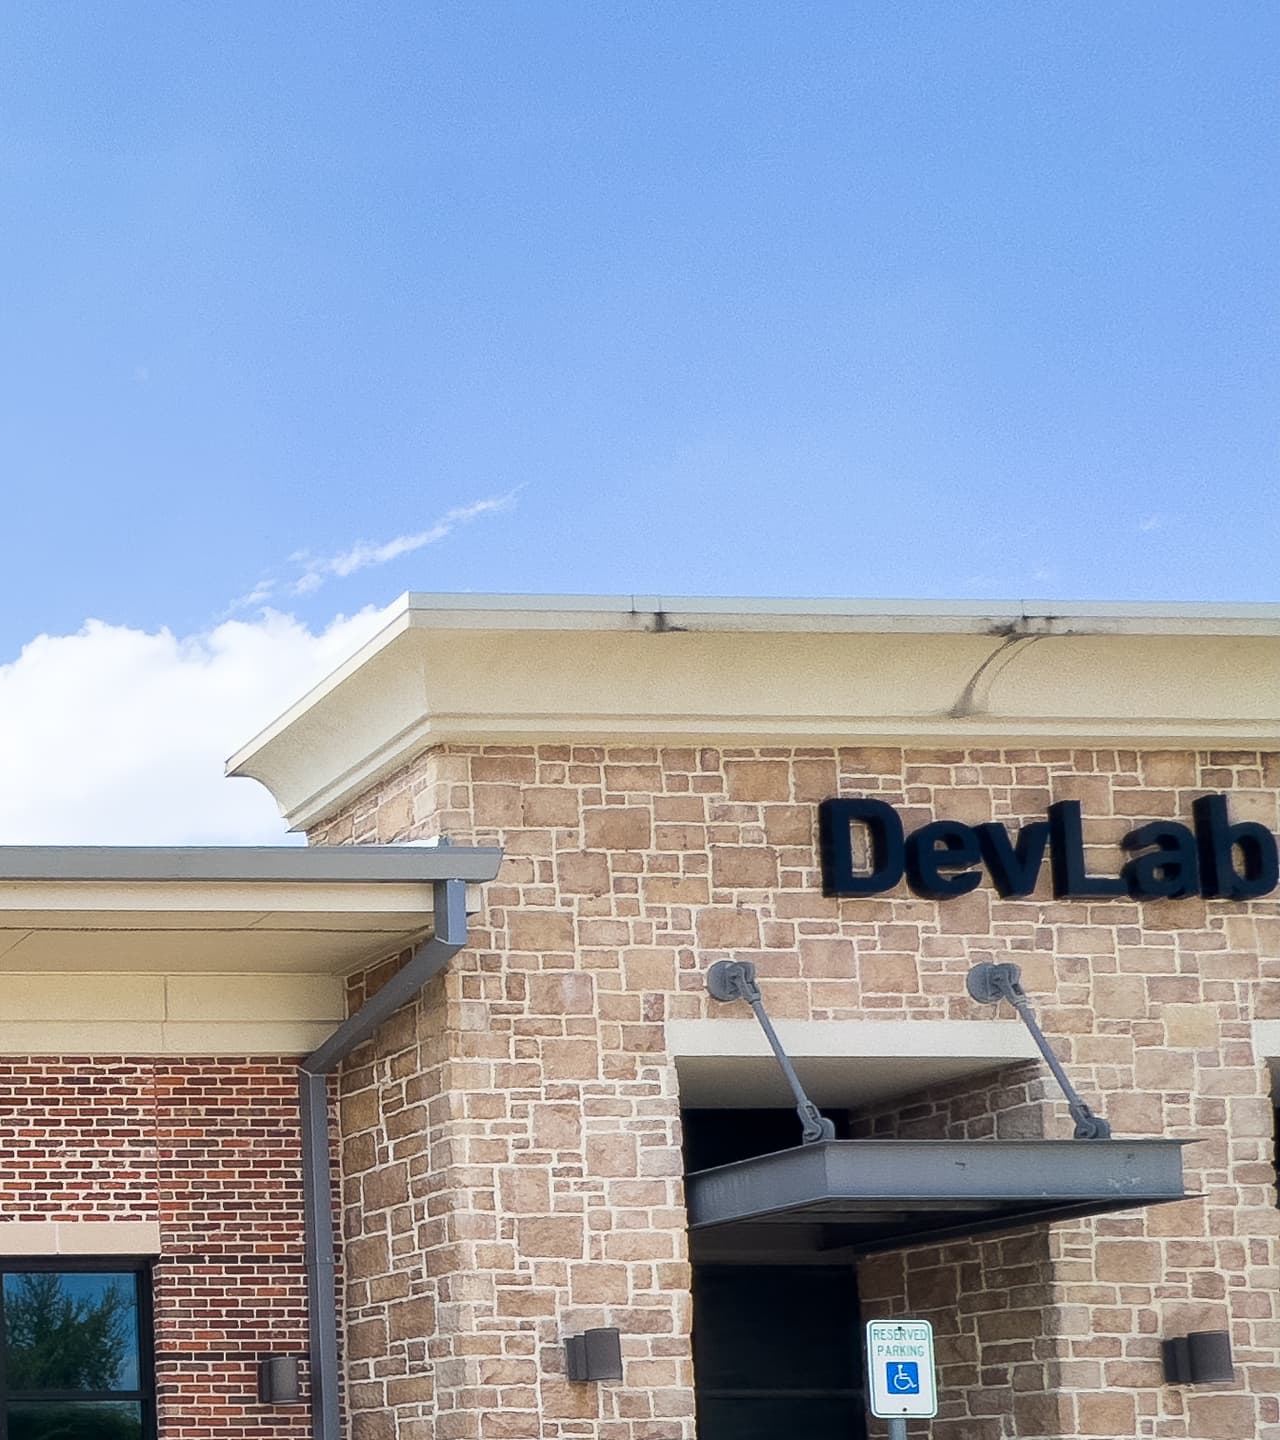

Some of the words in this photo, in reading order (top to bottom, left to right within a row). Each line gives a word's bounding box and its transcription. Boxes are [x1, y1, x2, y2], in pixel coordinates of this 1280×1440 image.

[818, 793, 1279, 901] DevLab
[872, 1329, 928, 1341] RESERVED
[877, 1345, 925, 1357] PARKING
